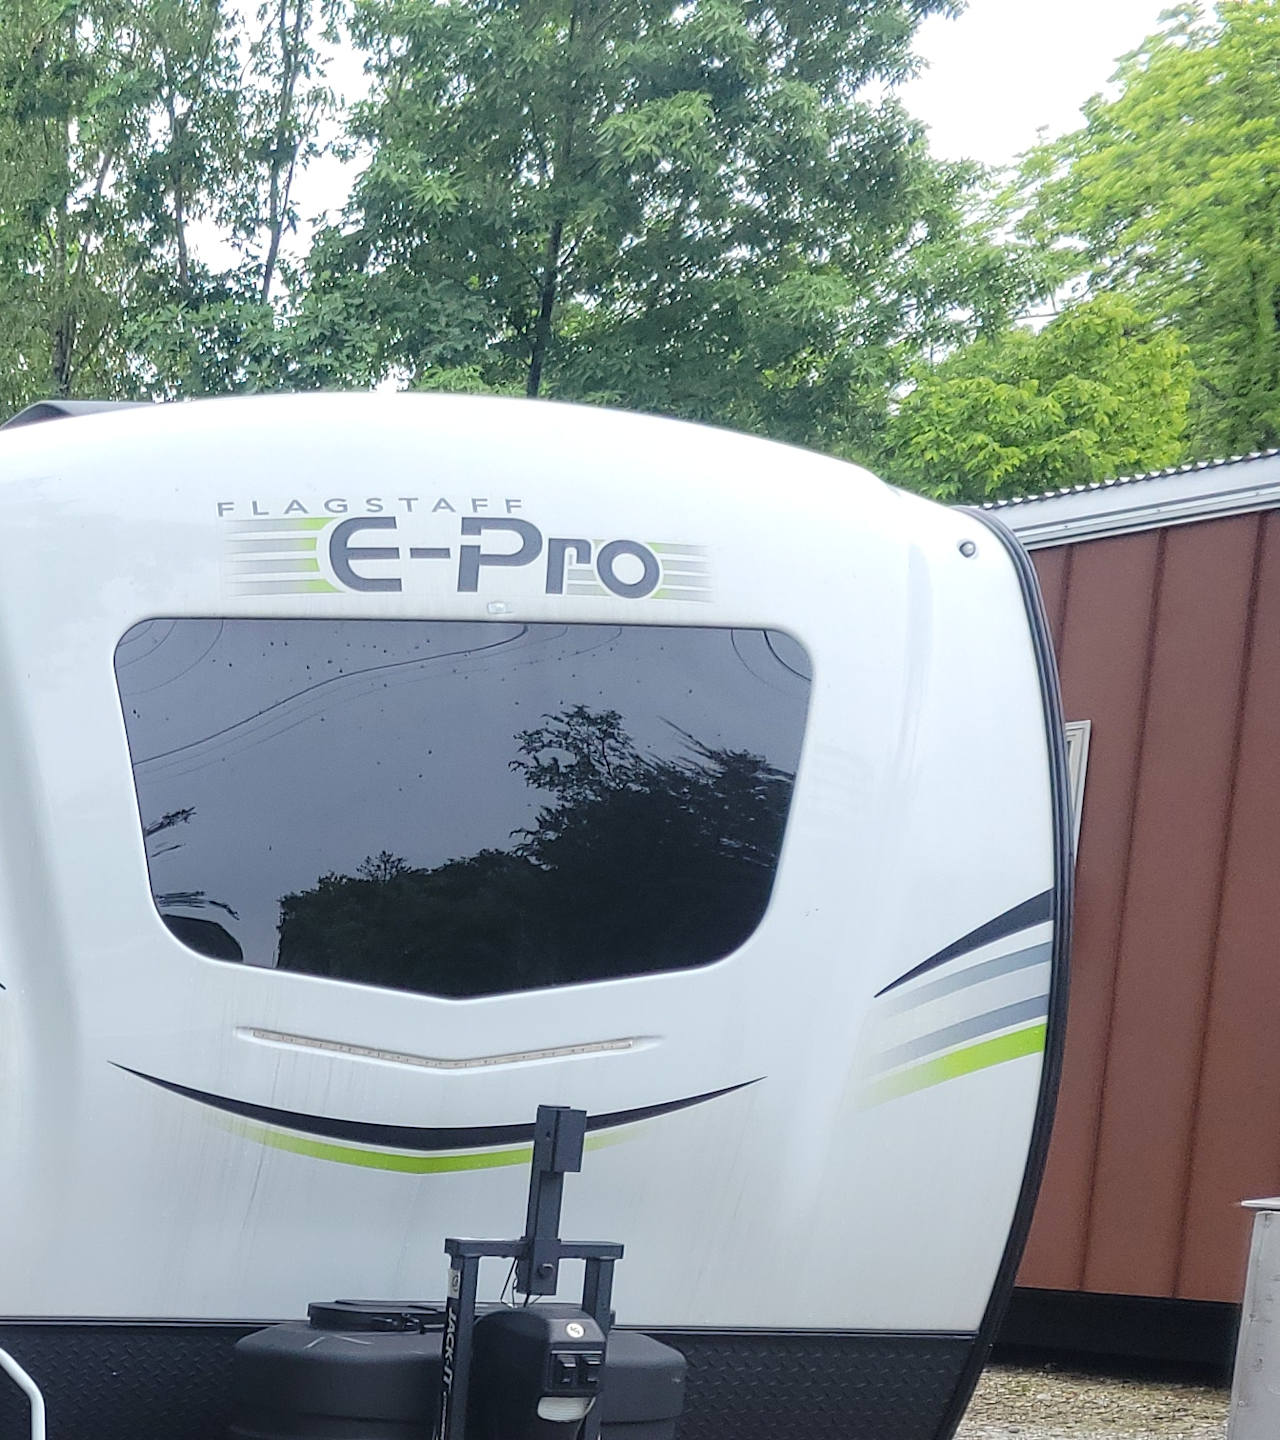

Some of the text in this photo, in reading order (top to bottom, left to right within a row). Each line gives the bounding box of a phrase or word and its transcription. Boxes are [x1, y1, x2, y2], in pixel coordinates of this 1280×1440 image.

[216, 497, 523, 518] FLAGSTAFF
[328, 515, 662, 601] E-Pro
[443, 1307, 458, 1396] JACK-IT
